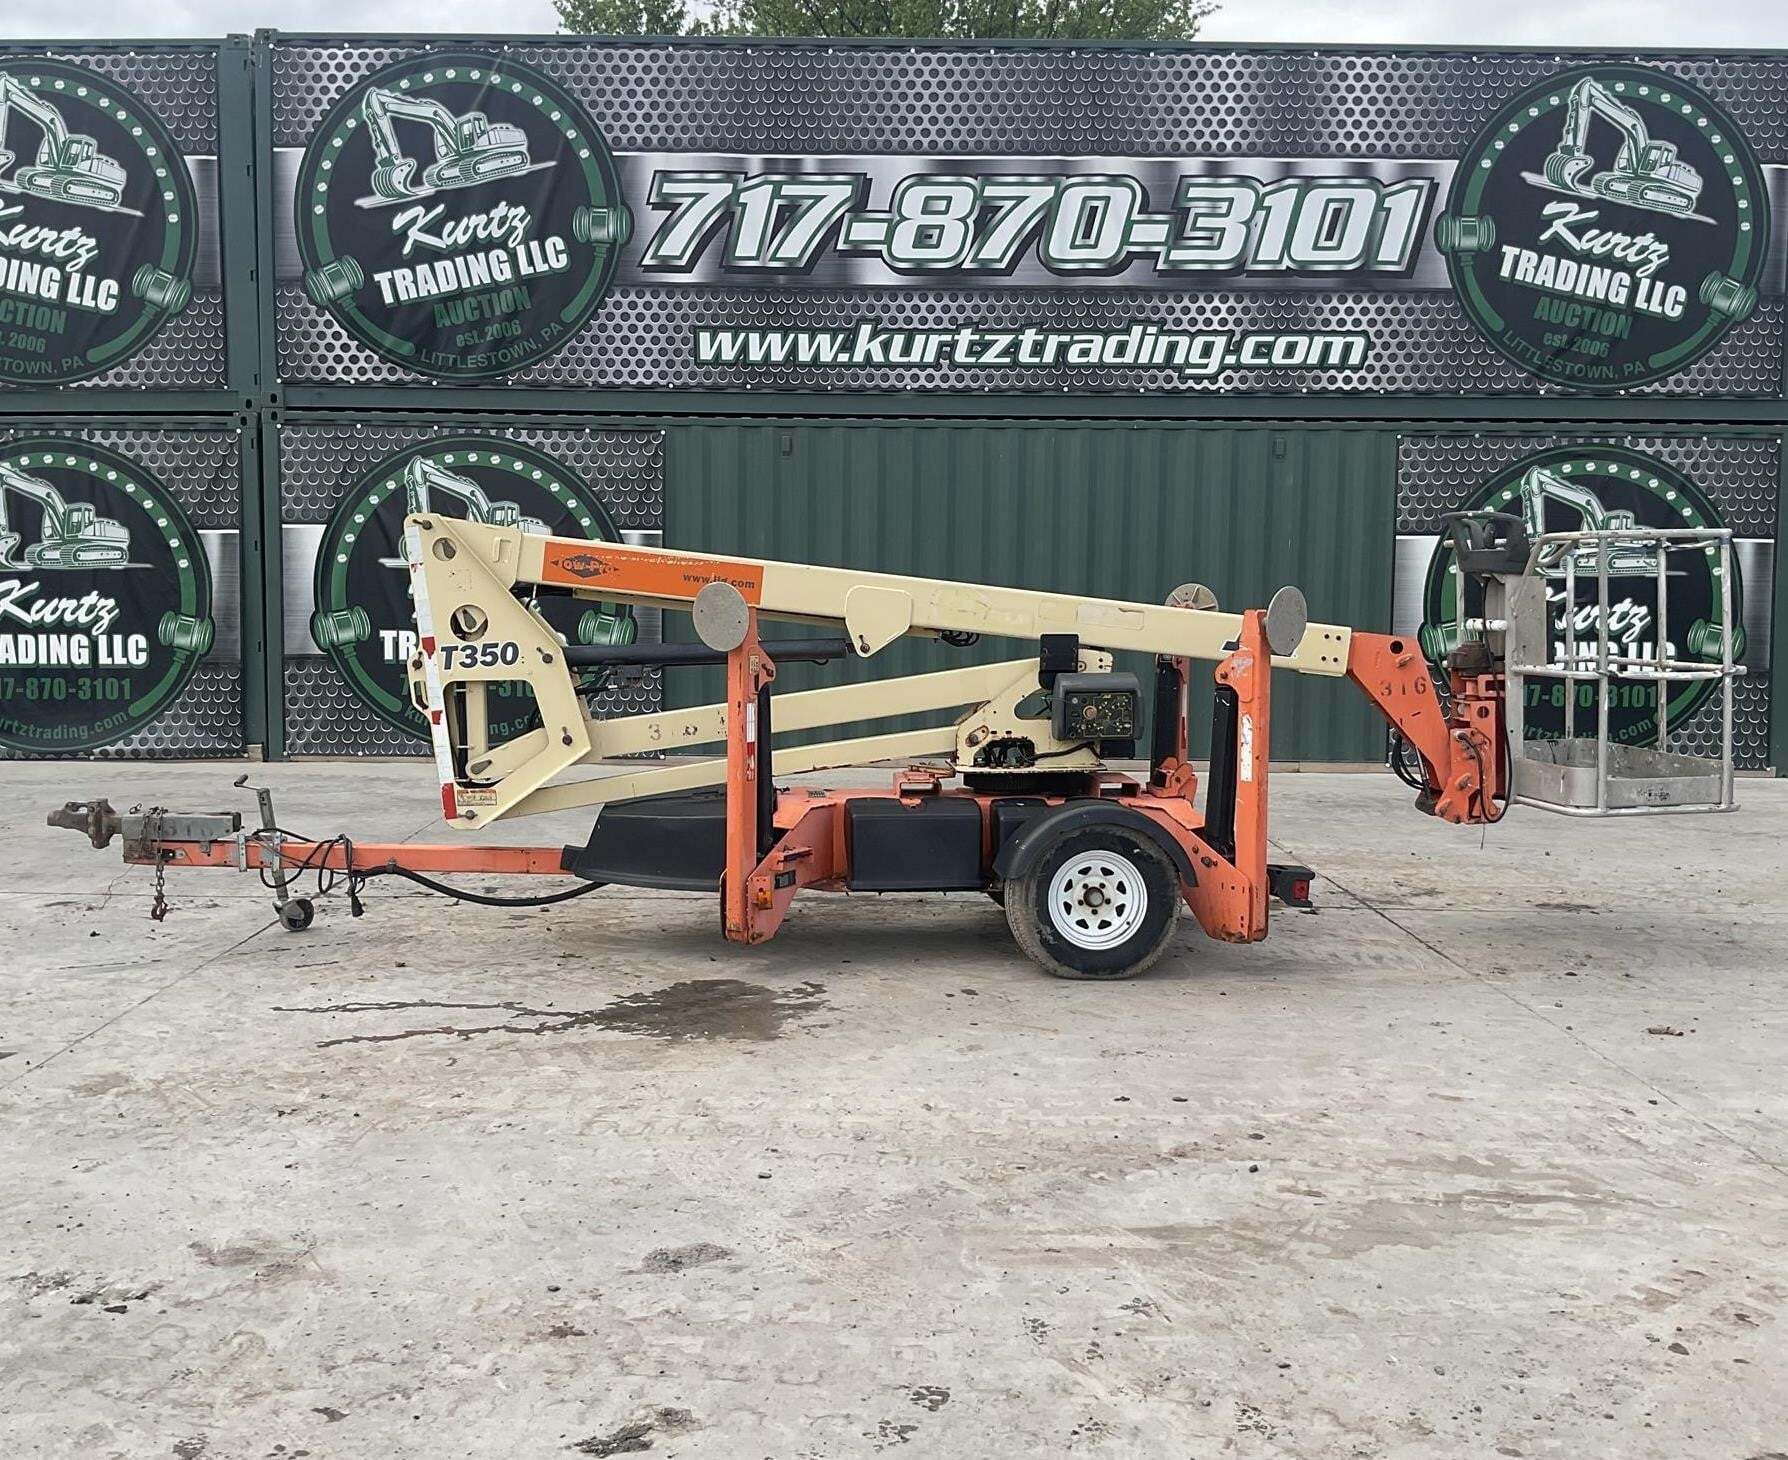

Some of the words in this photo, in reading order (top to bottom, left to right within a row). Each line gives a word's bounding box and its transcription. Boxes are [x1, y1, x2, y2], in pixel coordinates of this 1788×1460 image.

[392, 200, 531, 255] Kurtz
[645, 174, 1428, 270] 717-870-3101
[1539, 200, 1670, 278] Kurtz
[67, 272, 119, 311] LLC
[373, 249, 513, 304] TRADING
[515, 236, 568, 276] LLC
[1500, 244, 1631, 305] TRADING
[1635, 277, 1687, 318] LLC
[433, 285, 532, 328] AUCTION
[1533, 296, 1633, 340] AUCTION
[540, 322, 563, 341] PA
[697, 323, 1370, 376] www.kurtztrading.com
[61, 355, 85, 371] PA
[1623, 360, 1646, 376] PA
[0, 579, 120, 636] Kurtz
[98, 633, 147, 665] LLC
[441, 642, 519, 670] T350
[0, 677, 131, 700] 7-870-3101
